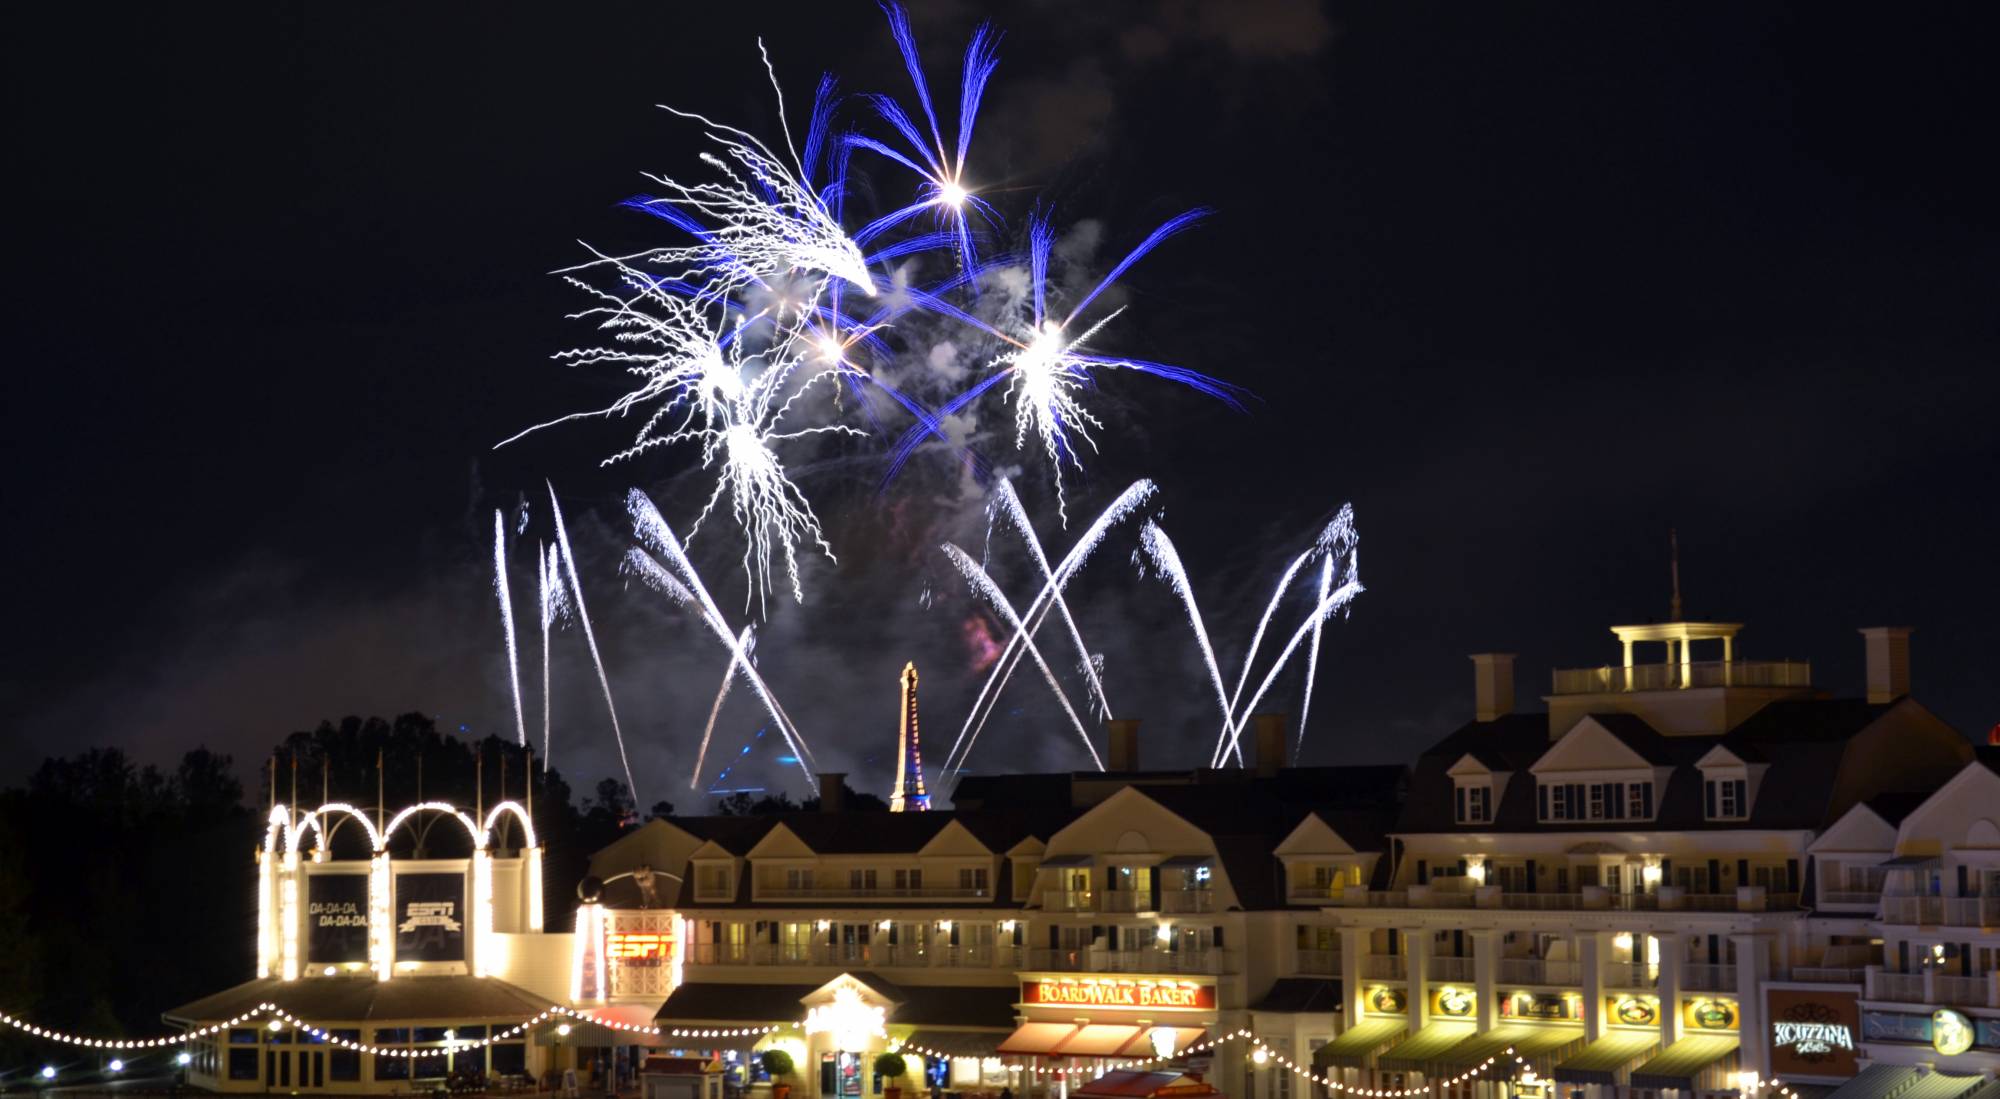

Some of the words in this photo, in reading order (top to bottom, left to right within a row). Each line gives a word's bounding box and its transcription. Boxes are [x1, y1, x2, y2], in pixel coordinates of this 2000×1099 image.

[407, 902, 454, 916] ESPN
[606, 935, 679, 957] ESPN
[1140, 986, 1197, 1006] BAKERY
